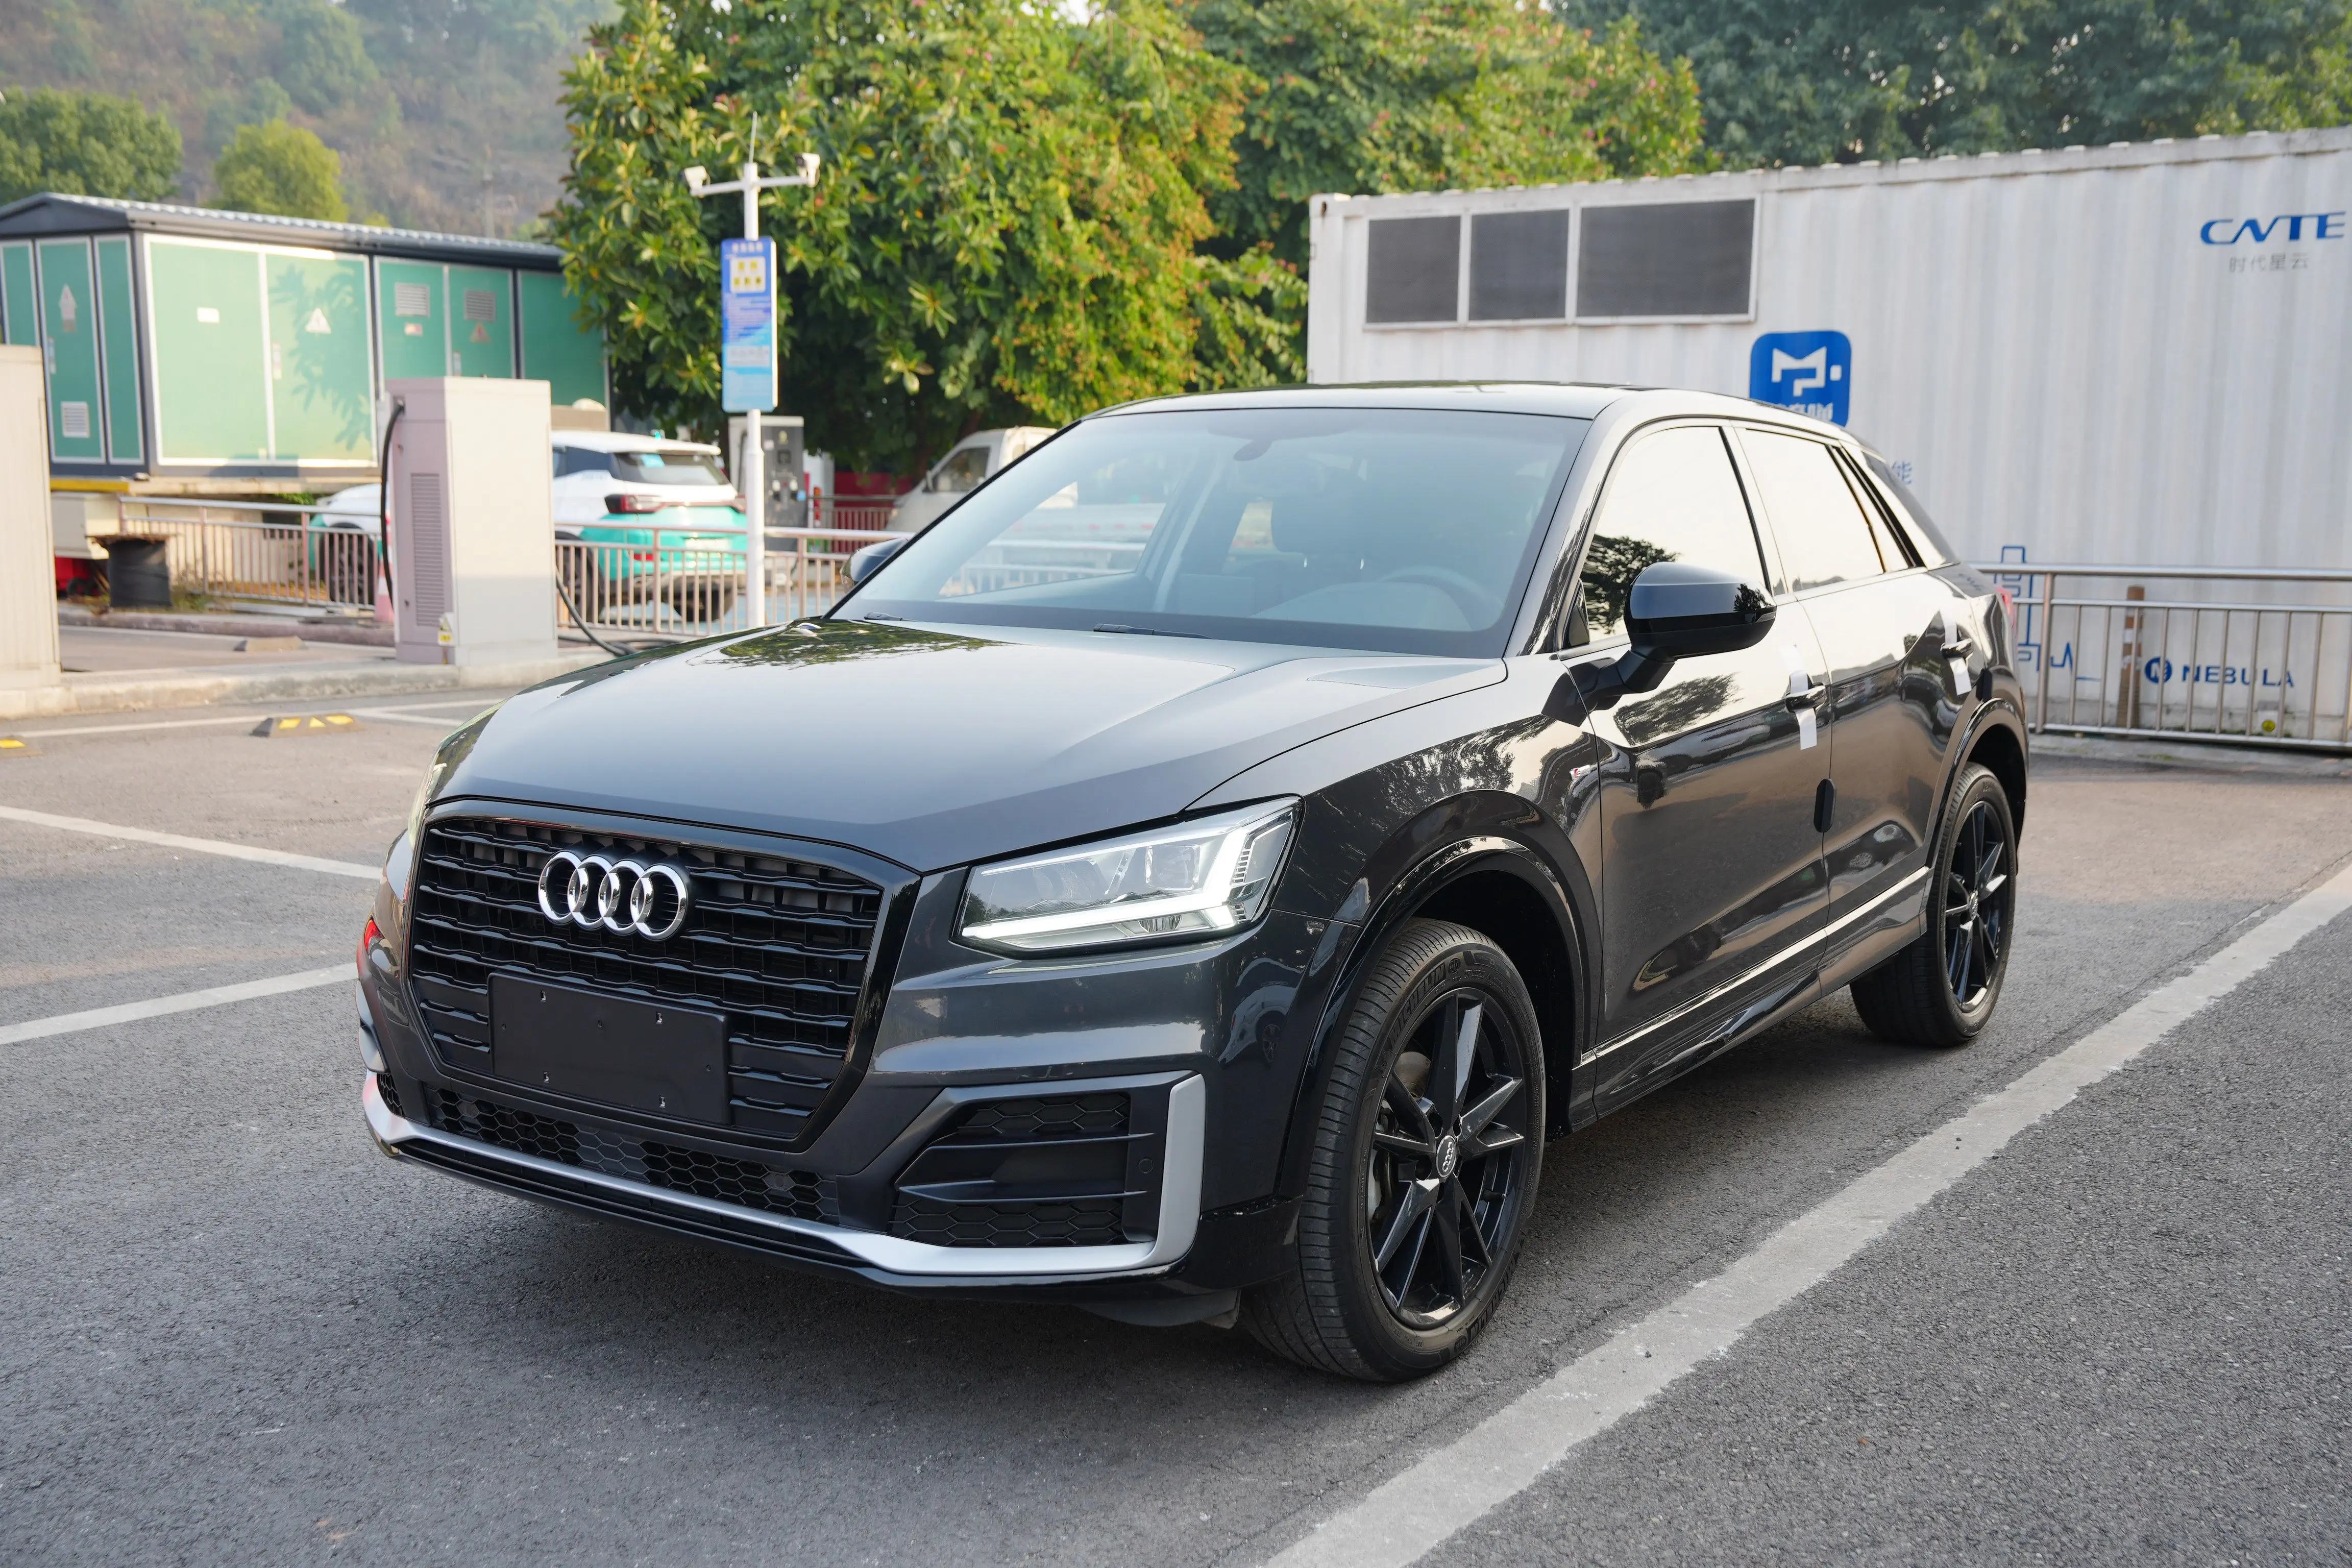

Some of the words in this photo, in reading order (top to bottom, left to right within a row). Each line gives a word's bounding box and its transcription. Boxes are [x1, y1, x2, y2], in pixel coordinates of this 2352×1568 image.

[2228, 252, 2310, 273] 时代星云
[2182, 665, 2294, 688] NEBULA
[1388, 962, 1446, 1049] MICHELIN
